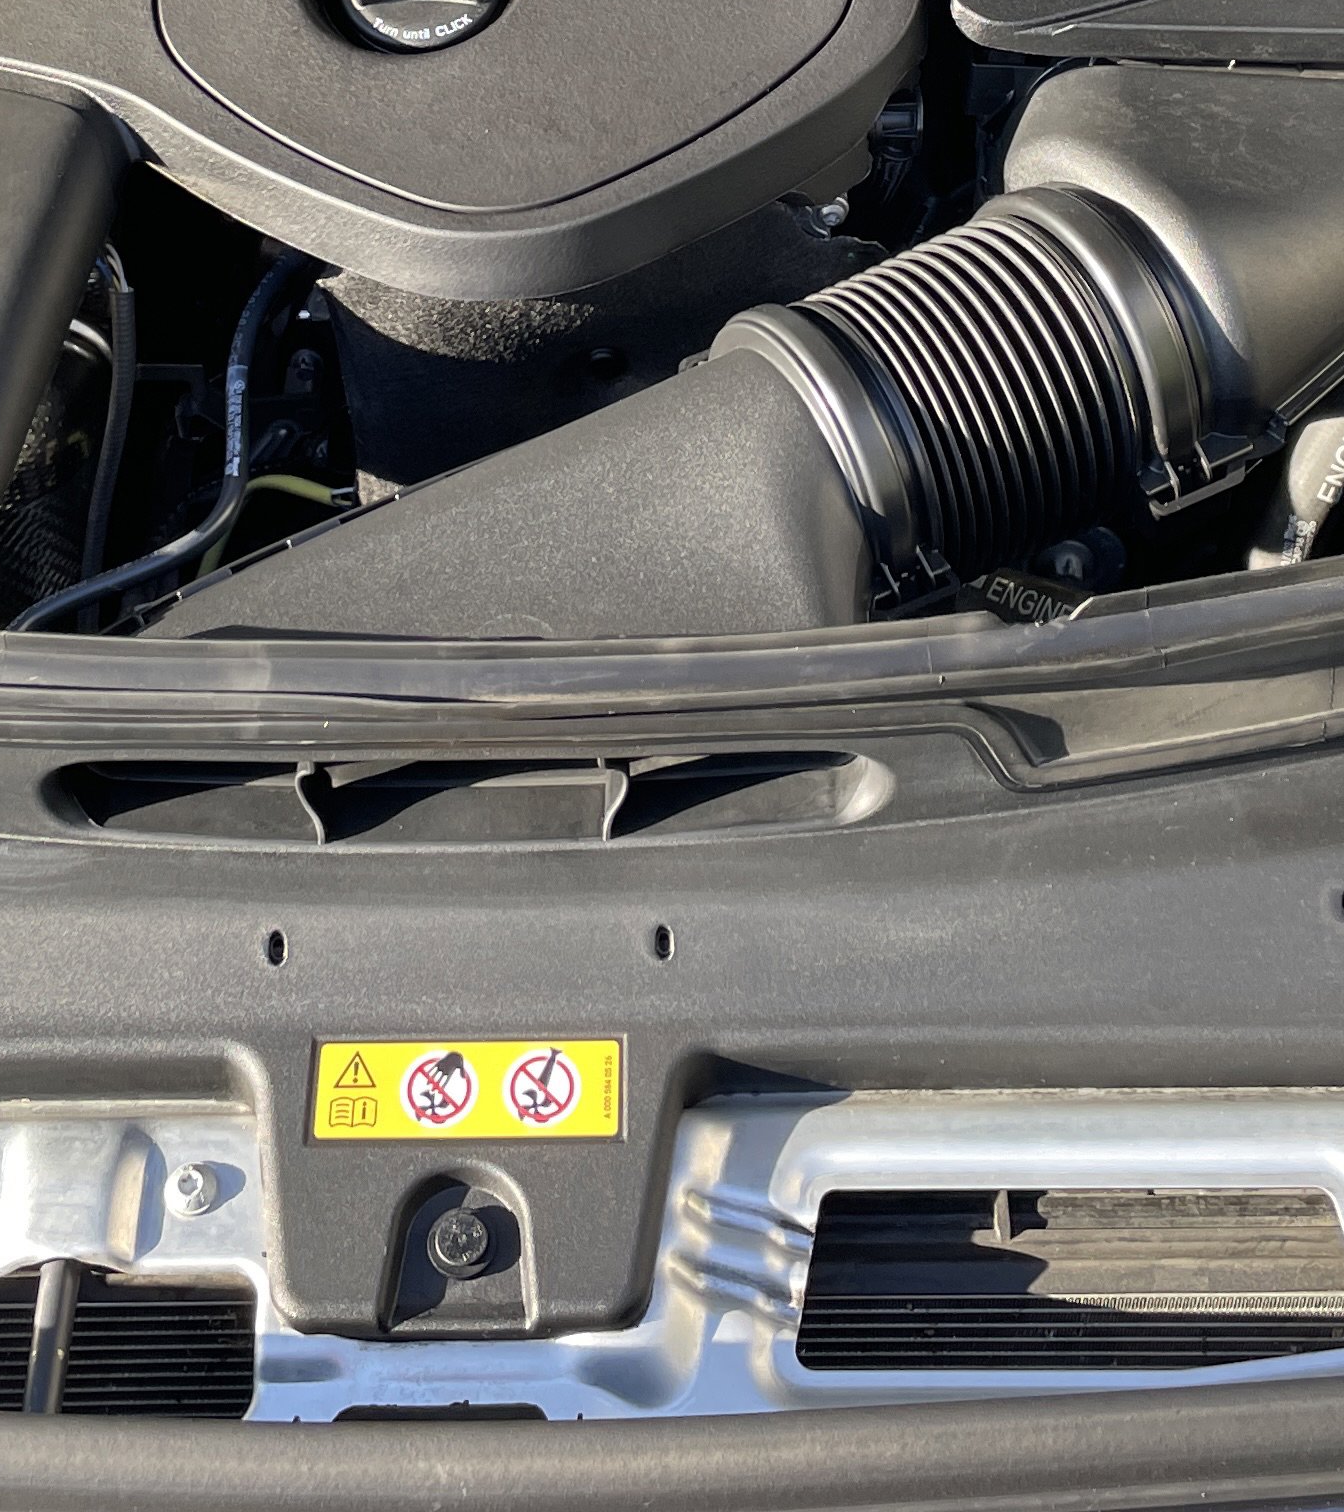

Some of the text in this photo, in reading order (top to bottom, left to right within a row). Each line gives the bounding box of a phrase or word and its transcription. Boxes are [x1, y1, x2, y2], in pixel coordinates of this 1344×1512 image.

[373, 13, 473, 40] Turn until CLICK
